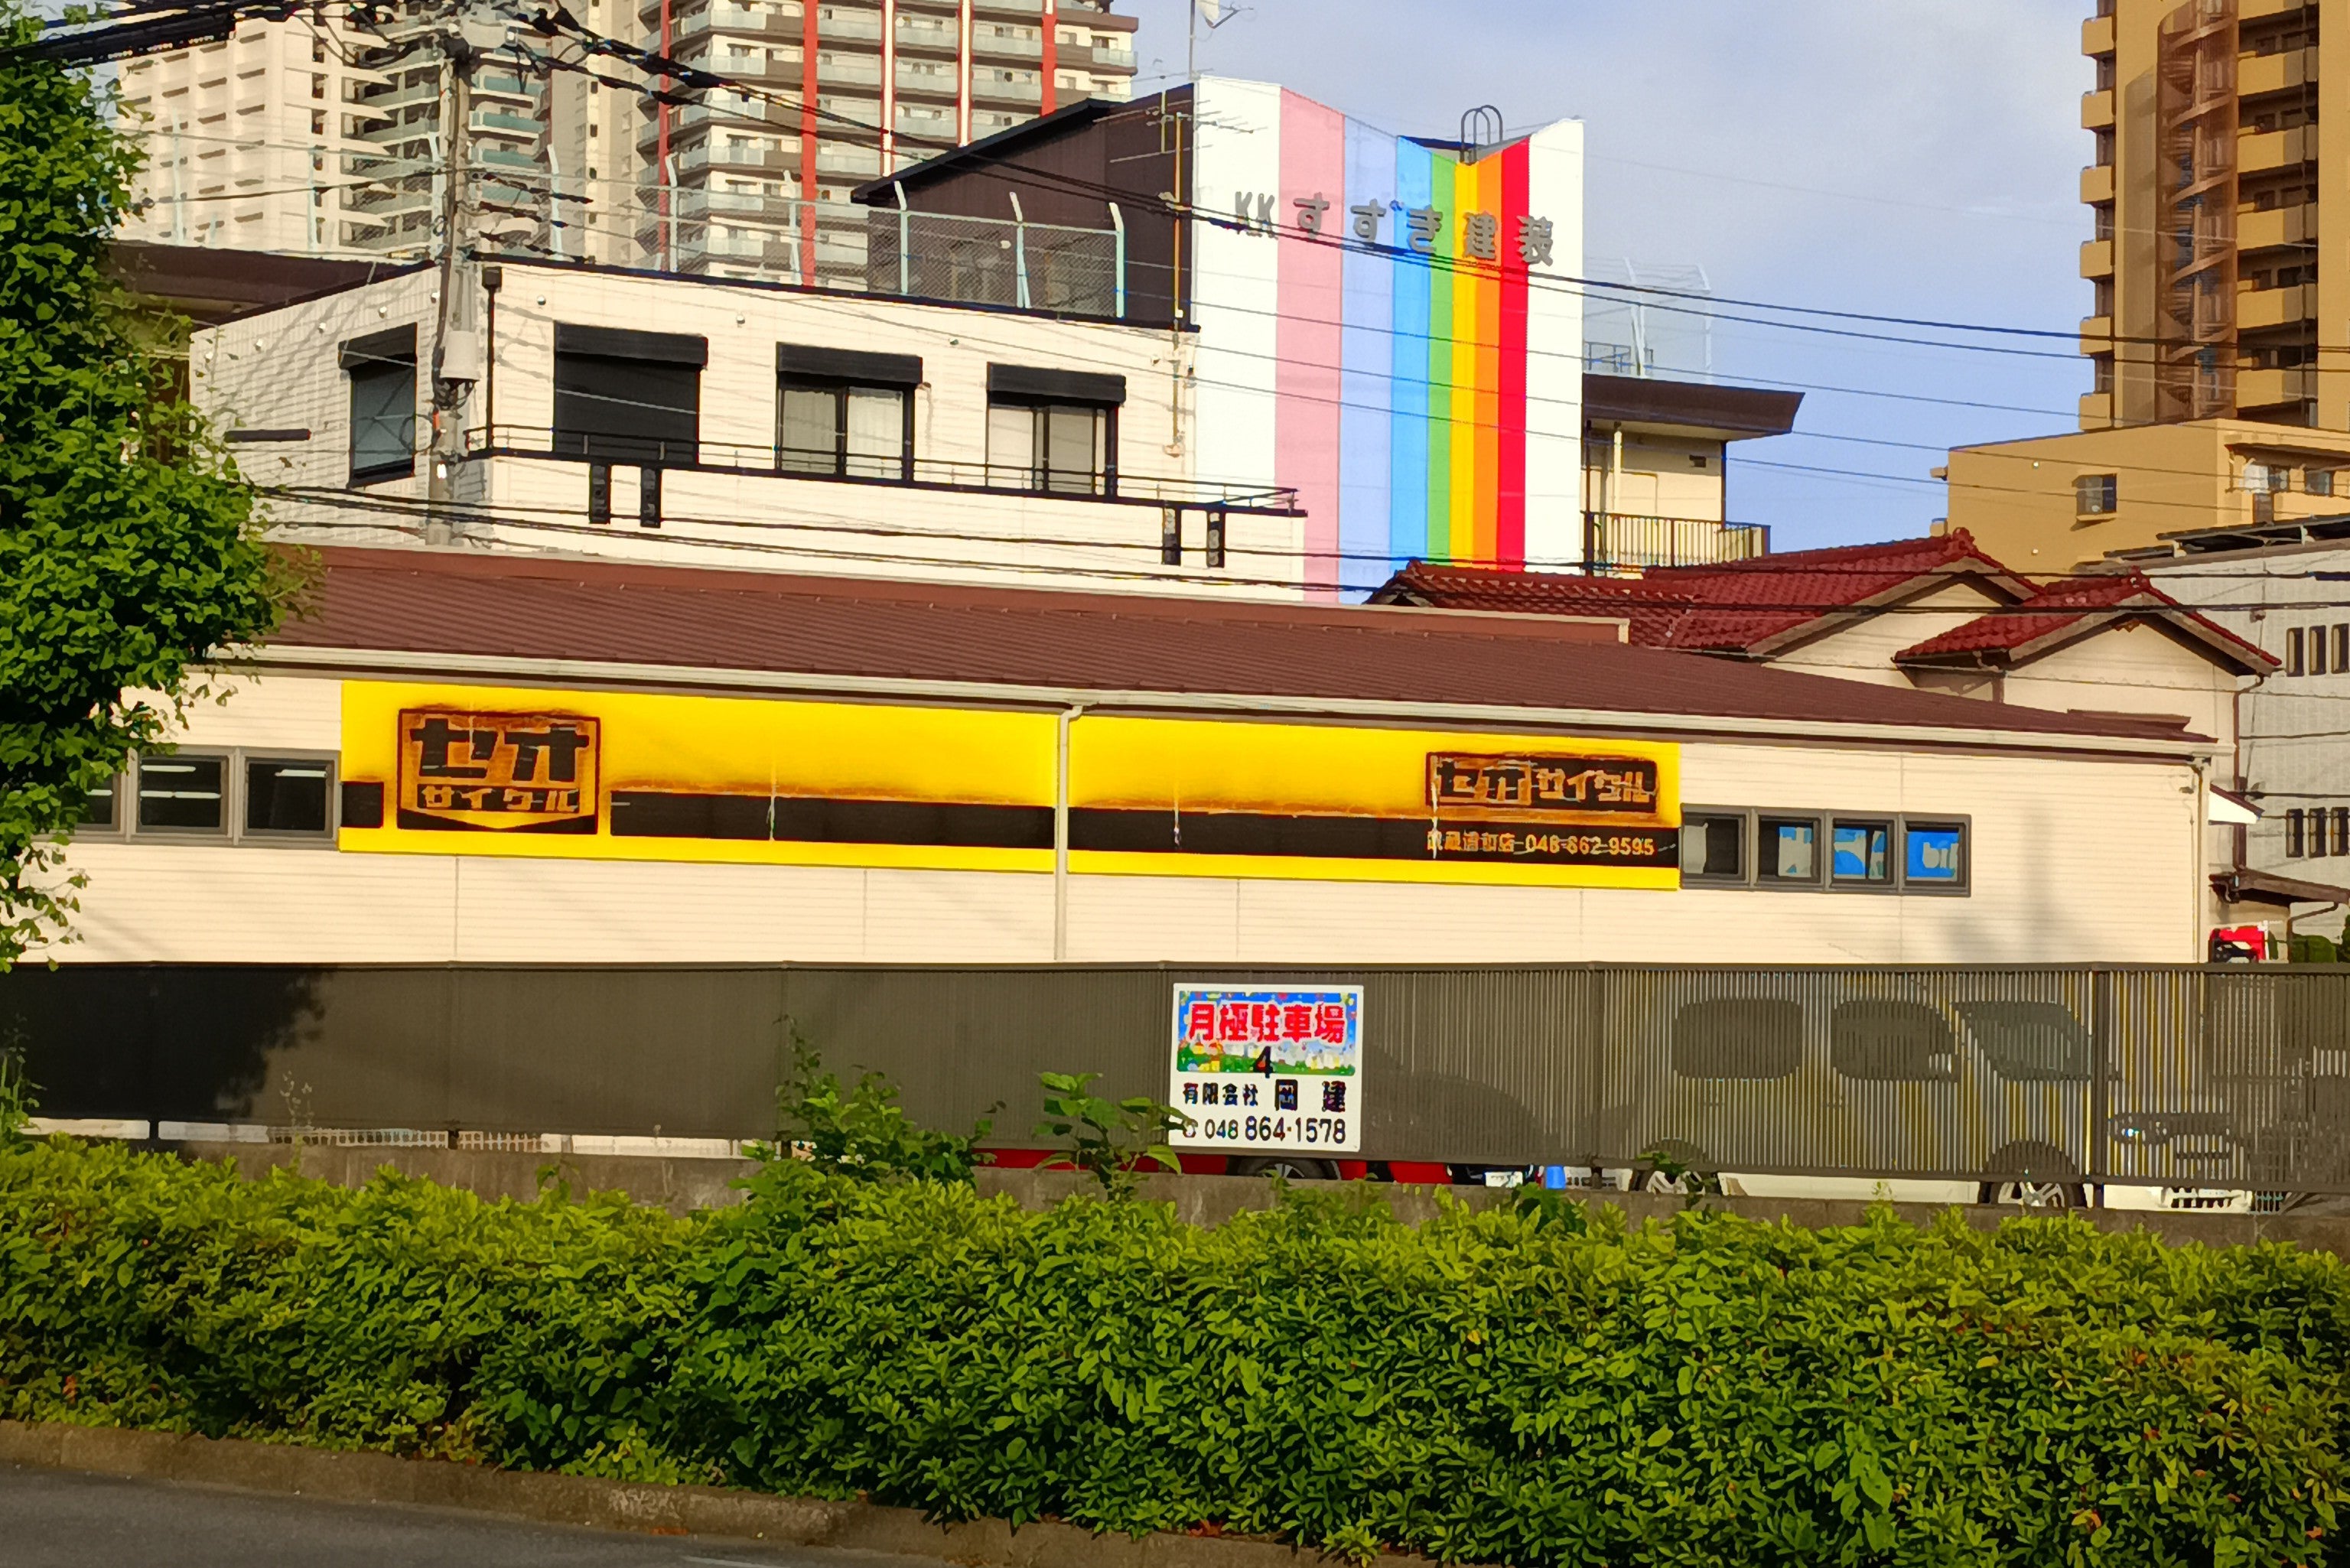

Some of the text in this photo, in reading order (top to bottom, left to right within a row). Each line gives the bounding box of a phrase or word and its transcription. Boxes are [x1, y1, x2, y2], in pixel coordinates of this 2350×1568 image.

[410, 718, 590, 782] セオ
[422, 785, 578, 812] サイクル
[1188, 1002, 1346, 1043] 月極駐車場
[1182, 1082, 1259, 1107] 有限会社
